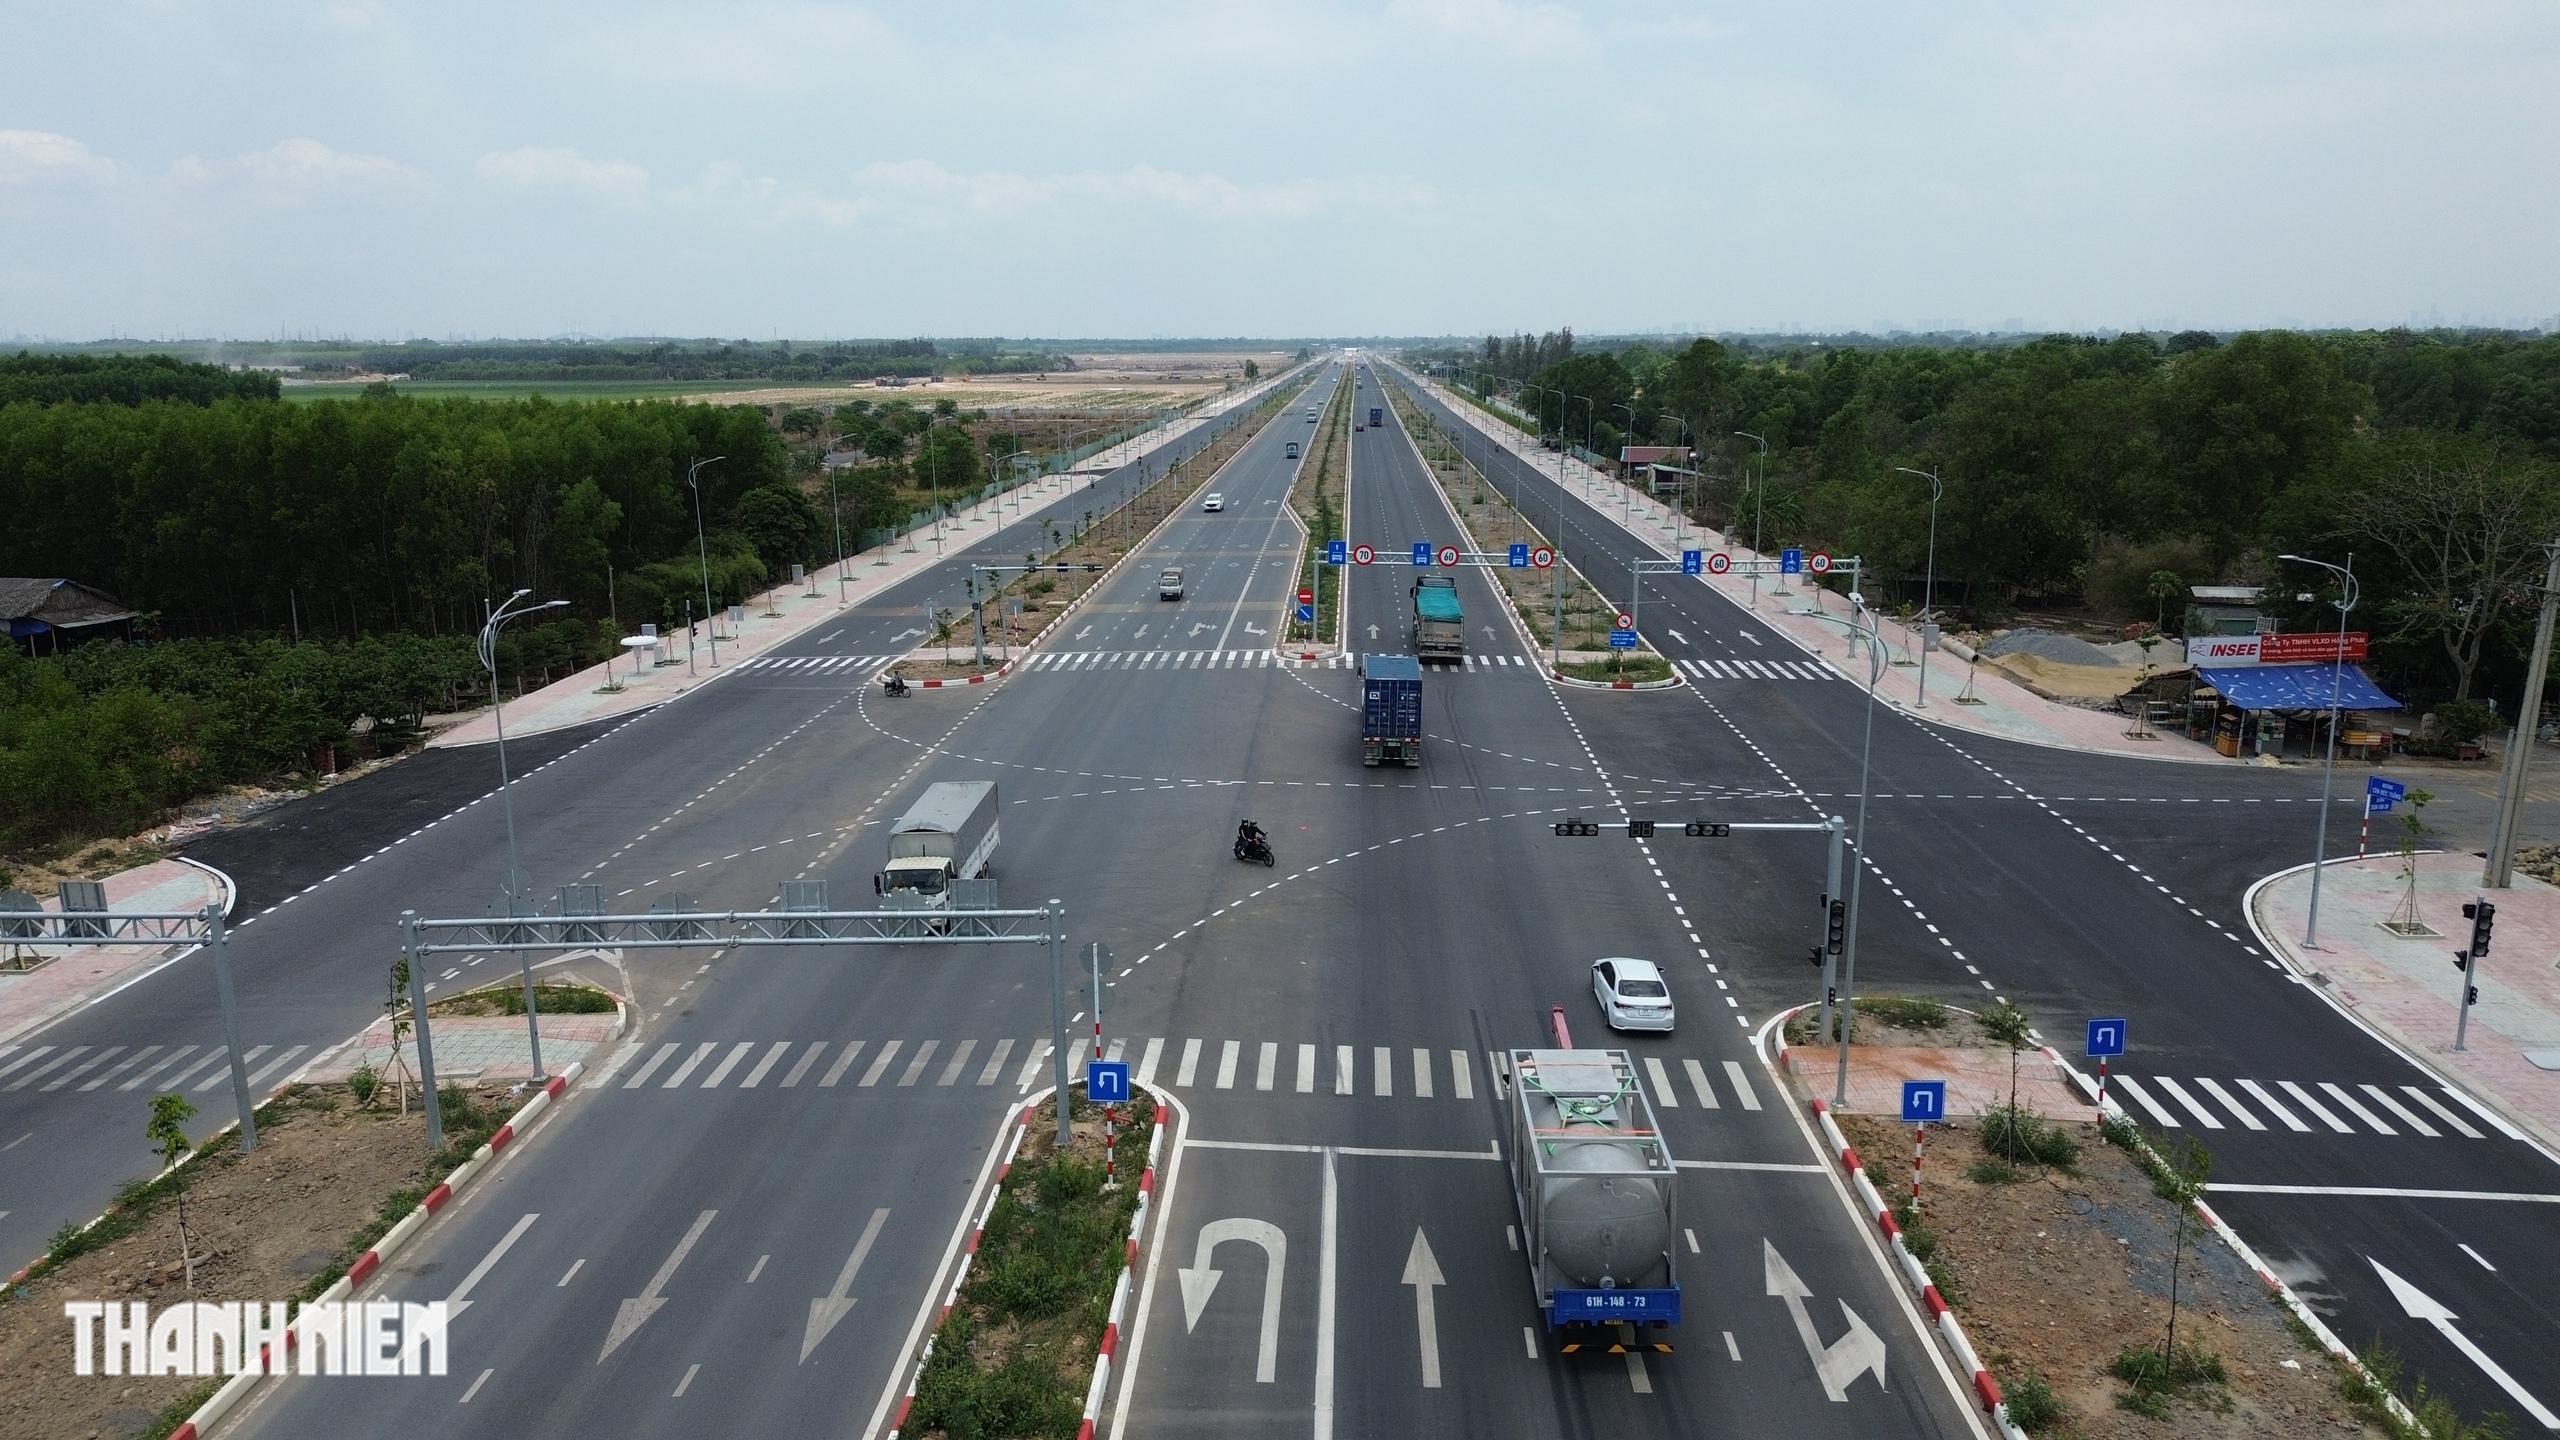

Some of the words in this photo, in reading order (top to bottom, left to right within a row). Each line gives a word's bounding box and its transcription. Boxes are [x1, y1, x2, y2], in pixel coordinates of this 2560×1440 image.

[1359, 551, 1369, 560] 70
[1443, 552, 1454, 562] 60
[1538, 553, 1548, 563] 60
[1714, 559, 1725, 569] 60
[1815, 558, 1825, 568] 60
[2291, 638, 2310, 646] TNHH
[2350, 636, 2365, 644] Phát
[2209, 643, 2258, 657] INSEE
[1586, 1296, 1603, 1307] 61H
[1609, 1296, 1625, 1307] 148
[1634, 1296, 1646, 1307] 73
